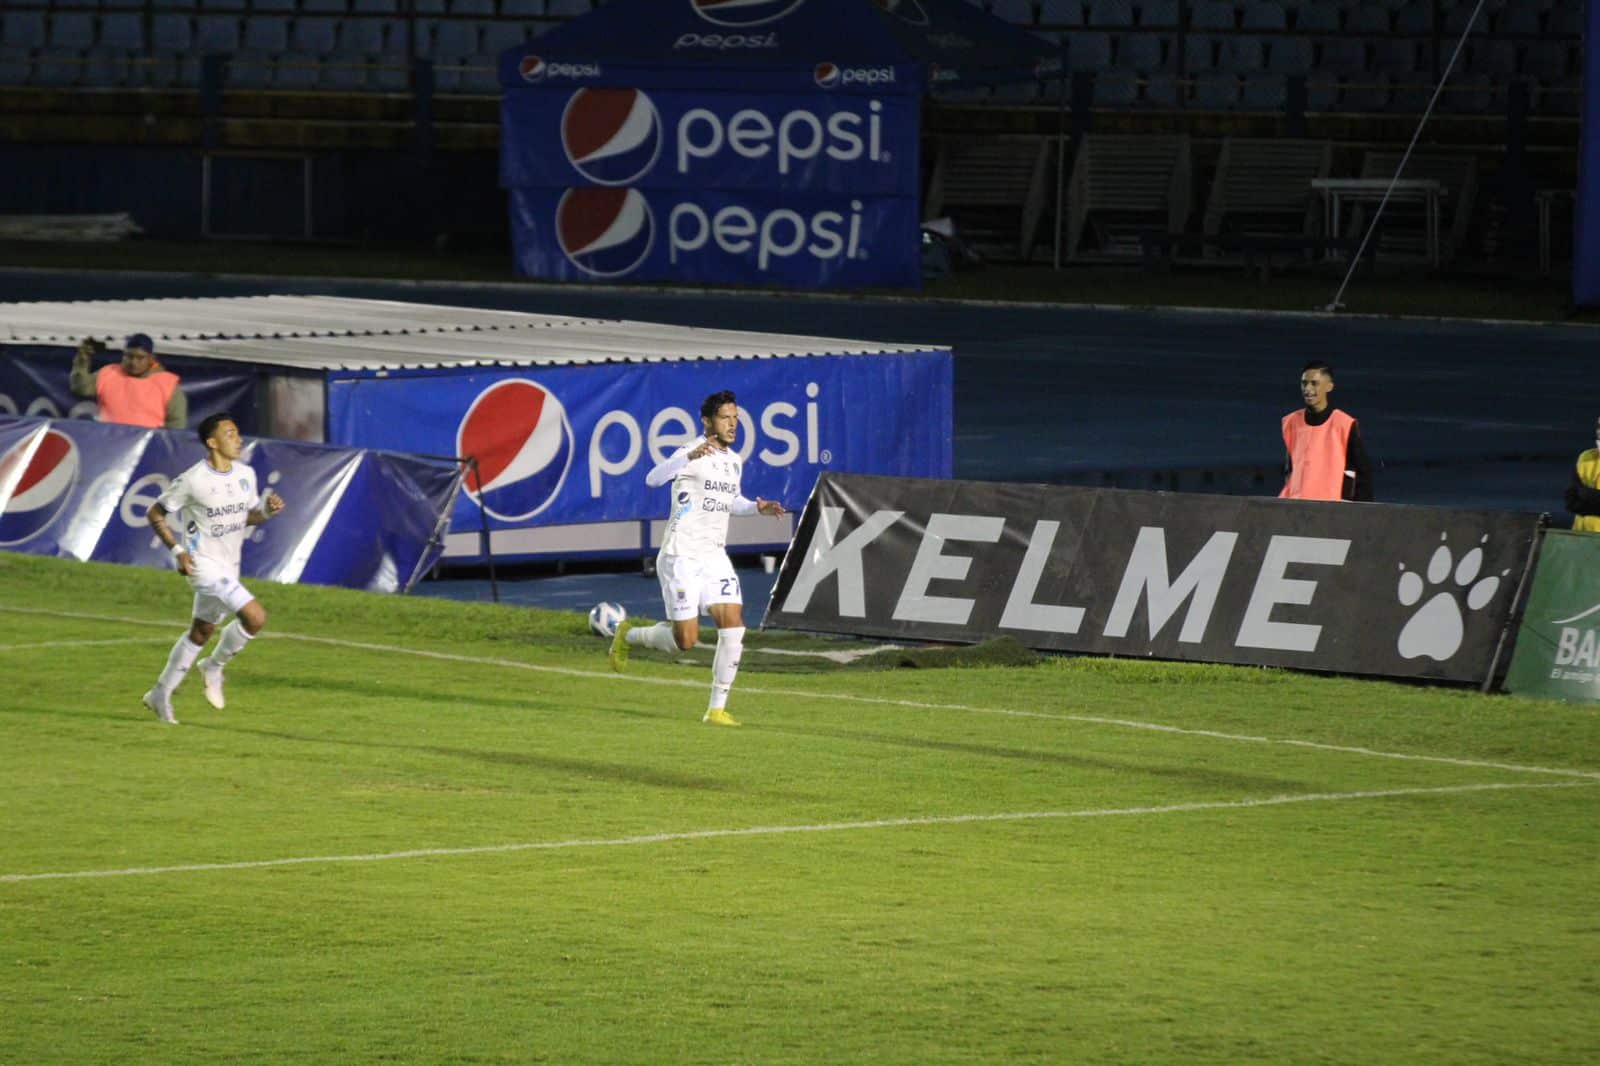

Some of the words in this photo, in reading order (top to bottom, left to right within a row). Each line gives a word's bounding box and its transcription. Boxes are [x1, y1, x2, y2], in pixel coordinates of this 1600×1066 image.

[673, 31, 779, 49] pepsi
[547, 61, 601, 79] pepsi
[842, 65, 896, 84] pepsi
[677, 100, 883, 174] pepsi
[669, 200, 864, 271] pepsi
[58, 470, 281, 550] pei
[719, 577, 740, 596] 27
[781, 506, 1353, 652] KELME
